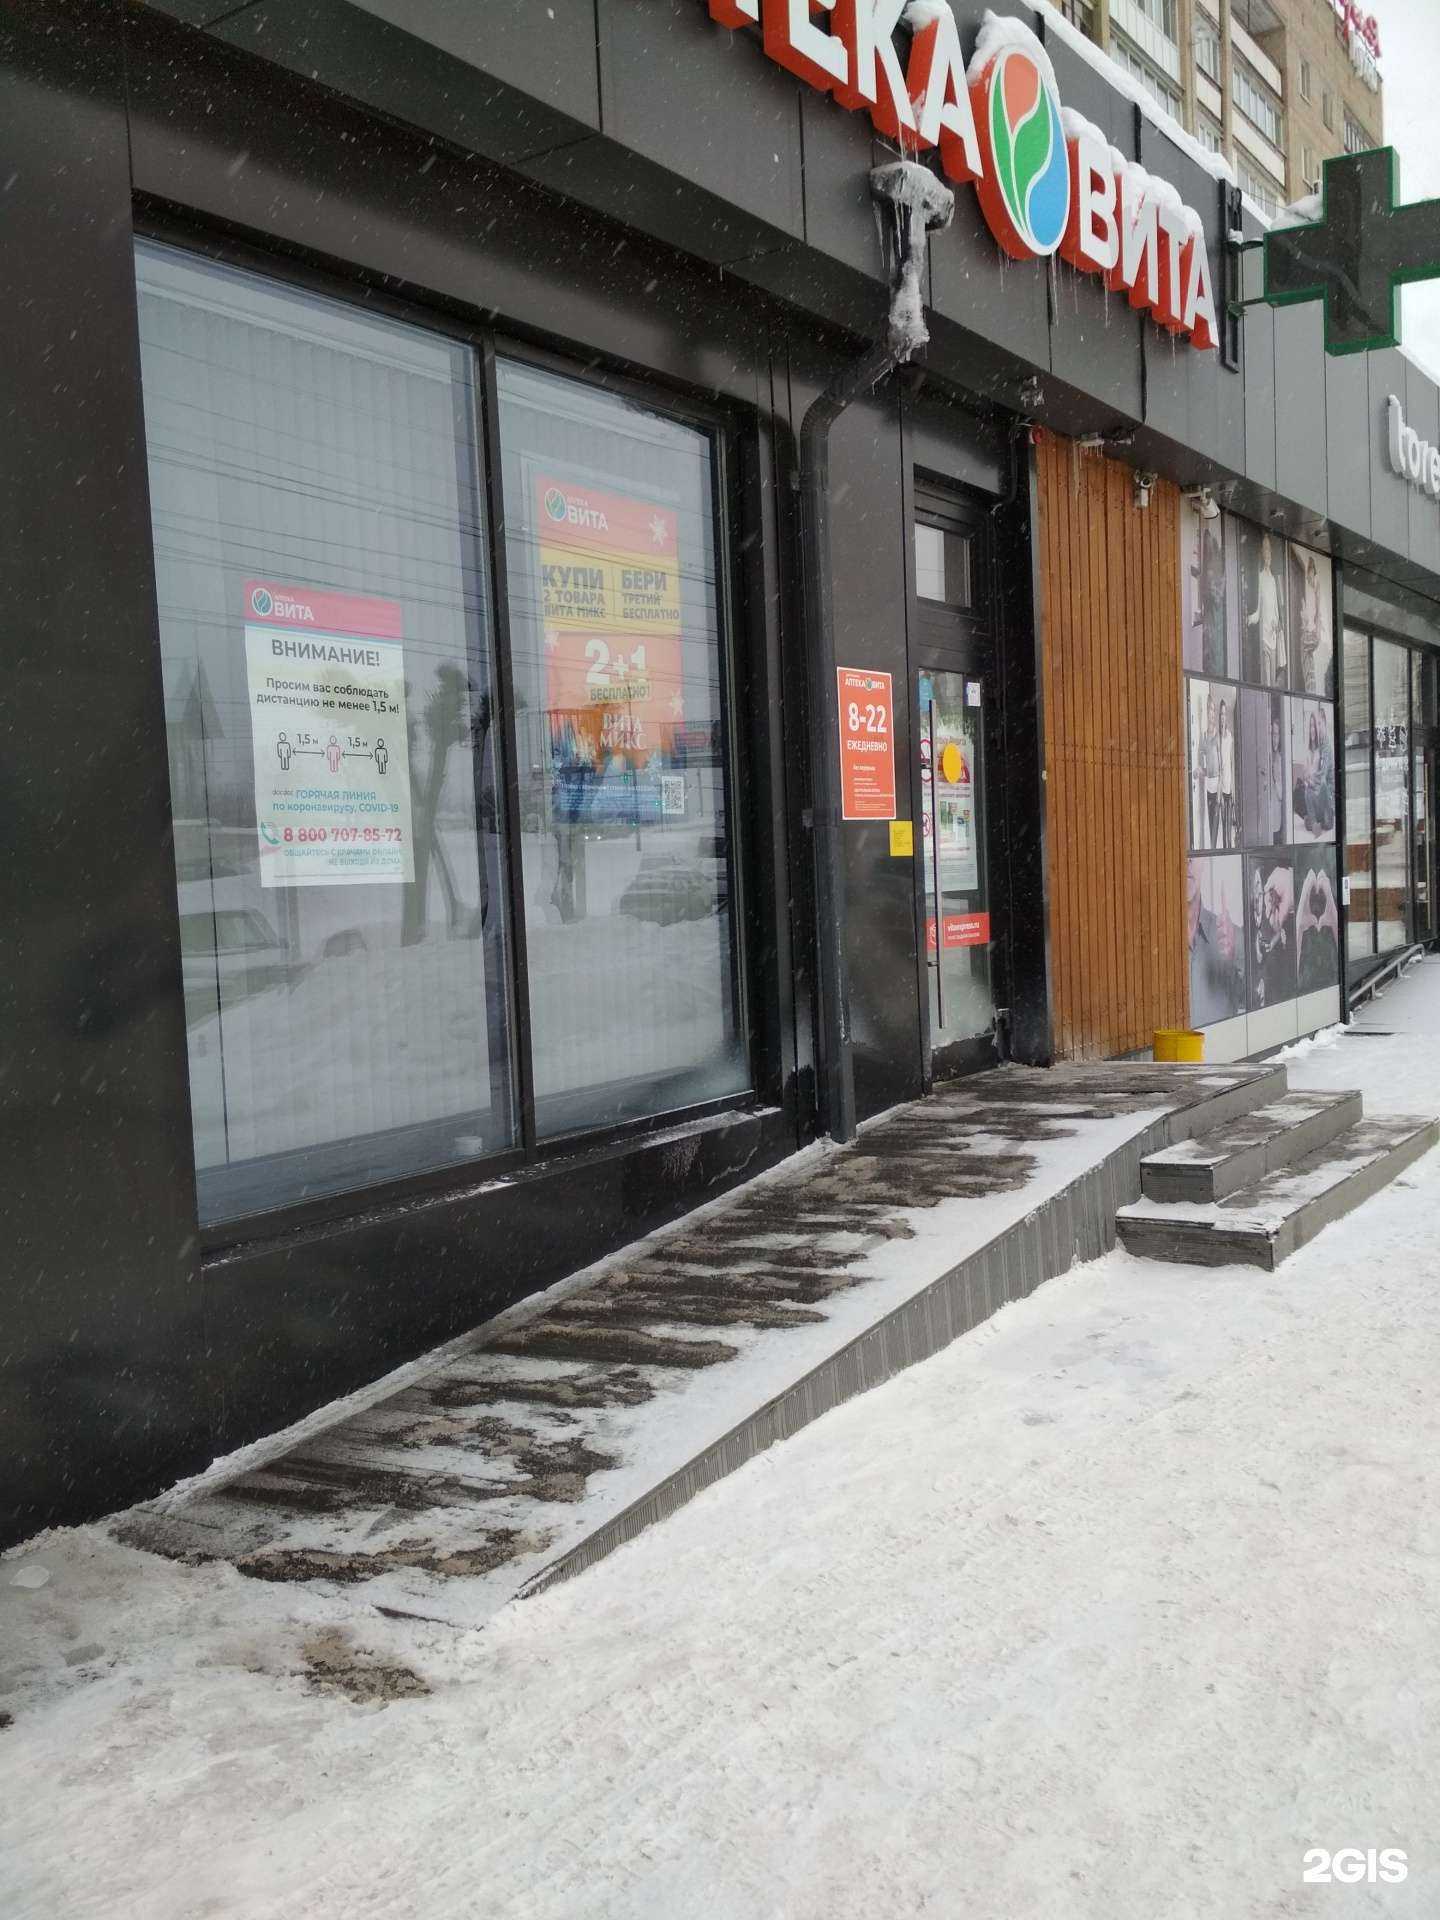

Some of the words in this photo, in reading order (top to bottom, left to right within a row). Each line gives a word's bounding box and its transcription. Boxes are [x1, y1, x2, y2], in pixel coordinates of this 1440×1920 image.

[712, 0, 983, 182] ЕКА
[1072, 135, 1219, 350] ВИТА
[567, 505, 608, 530] ВИТА
[542, 564, 604, 590] КУПИ
[622, 569, 667, 591] БЕРИ
[543, 590, 552, 603] 2
[556, 591, 606, 605] ТОВАРА
[622, 592, 662, 605] ТРЕТИЙ
[274, 601, 314, 621] ВИТА
[623, 608, 680, 620] БЕСПЛАТНО
[272, 639, 380, 666] ВНИМАНИЕ!
[584, 639, 646, 685] 2+1
[266, 678, 310, 692] Просим
[313, 682, 331, 693] вас
[333, 685, 389, 698] соблюдать
[256, 694, 320, 708] дистанцию
[322, 700, 336, 708] не
[338, 701, 370, 711] менее
[372, 701, 387, 714] 1,5
[389, 703, 400, 714] м!
[848, 702, 887, 733] 8-22
[296, 733, 311, 745] 1,5
[347, 736, 361, 748] 1,5
[600, 732, 648, 750] МИКС
[847, 739, 888, 752] ЕЖЕДНЕВНО
[295, 790, 339, 801] ГОРЯЧАЯ
[341, 790, 376, 801] ЛИНИЯ
[272, 803, 285, 811] по
[358, 803, 399, 813] COVID-19
[283, 827, 293, 842] 8
[298, 827, 327, 842] 800
[331, 827, 402, 842] 707-85-72
